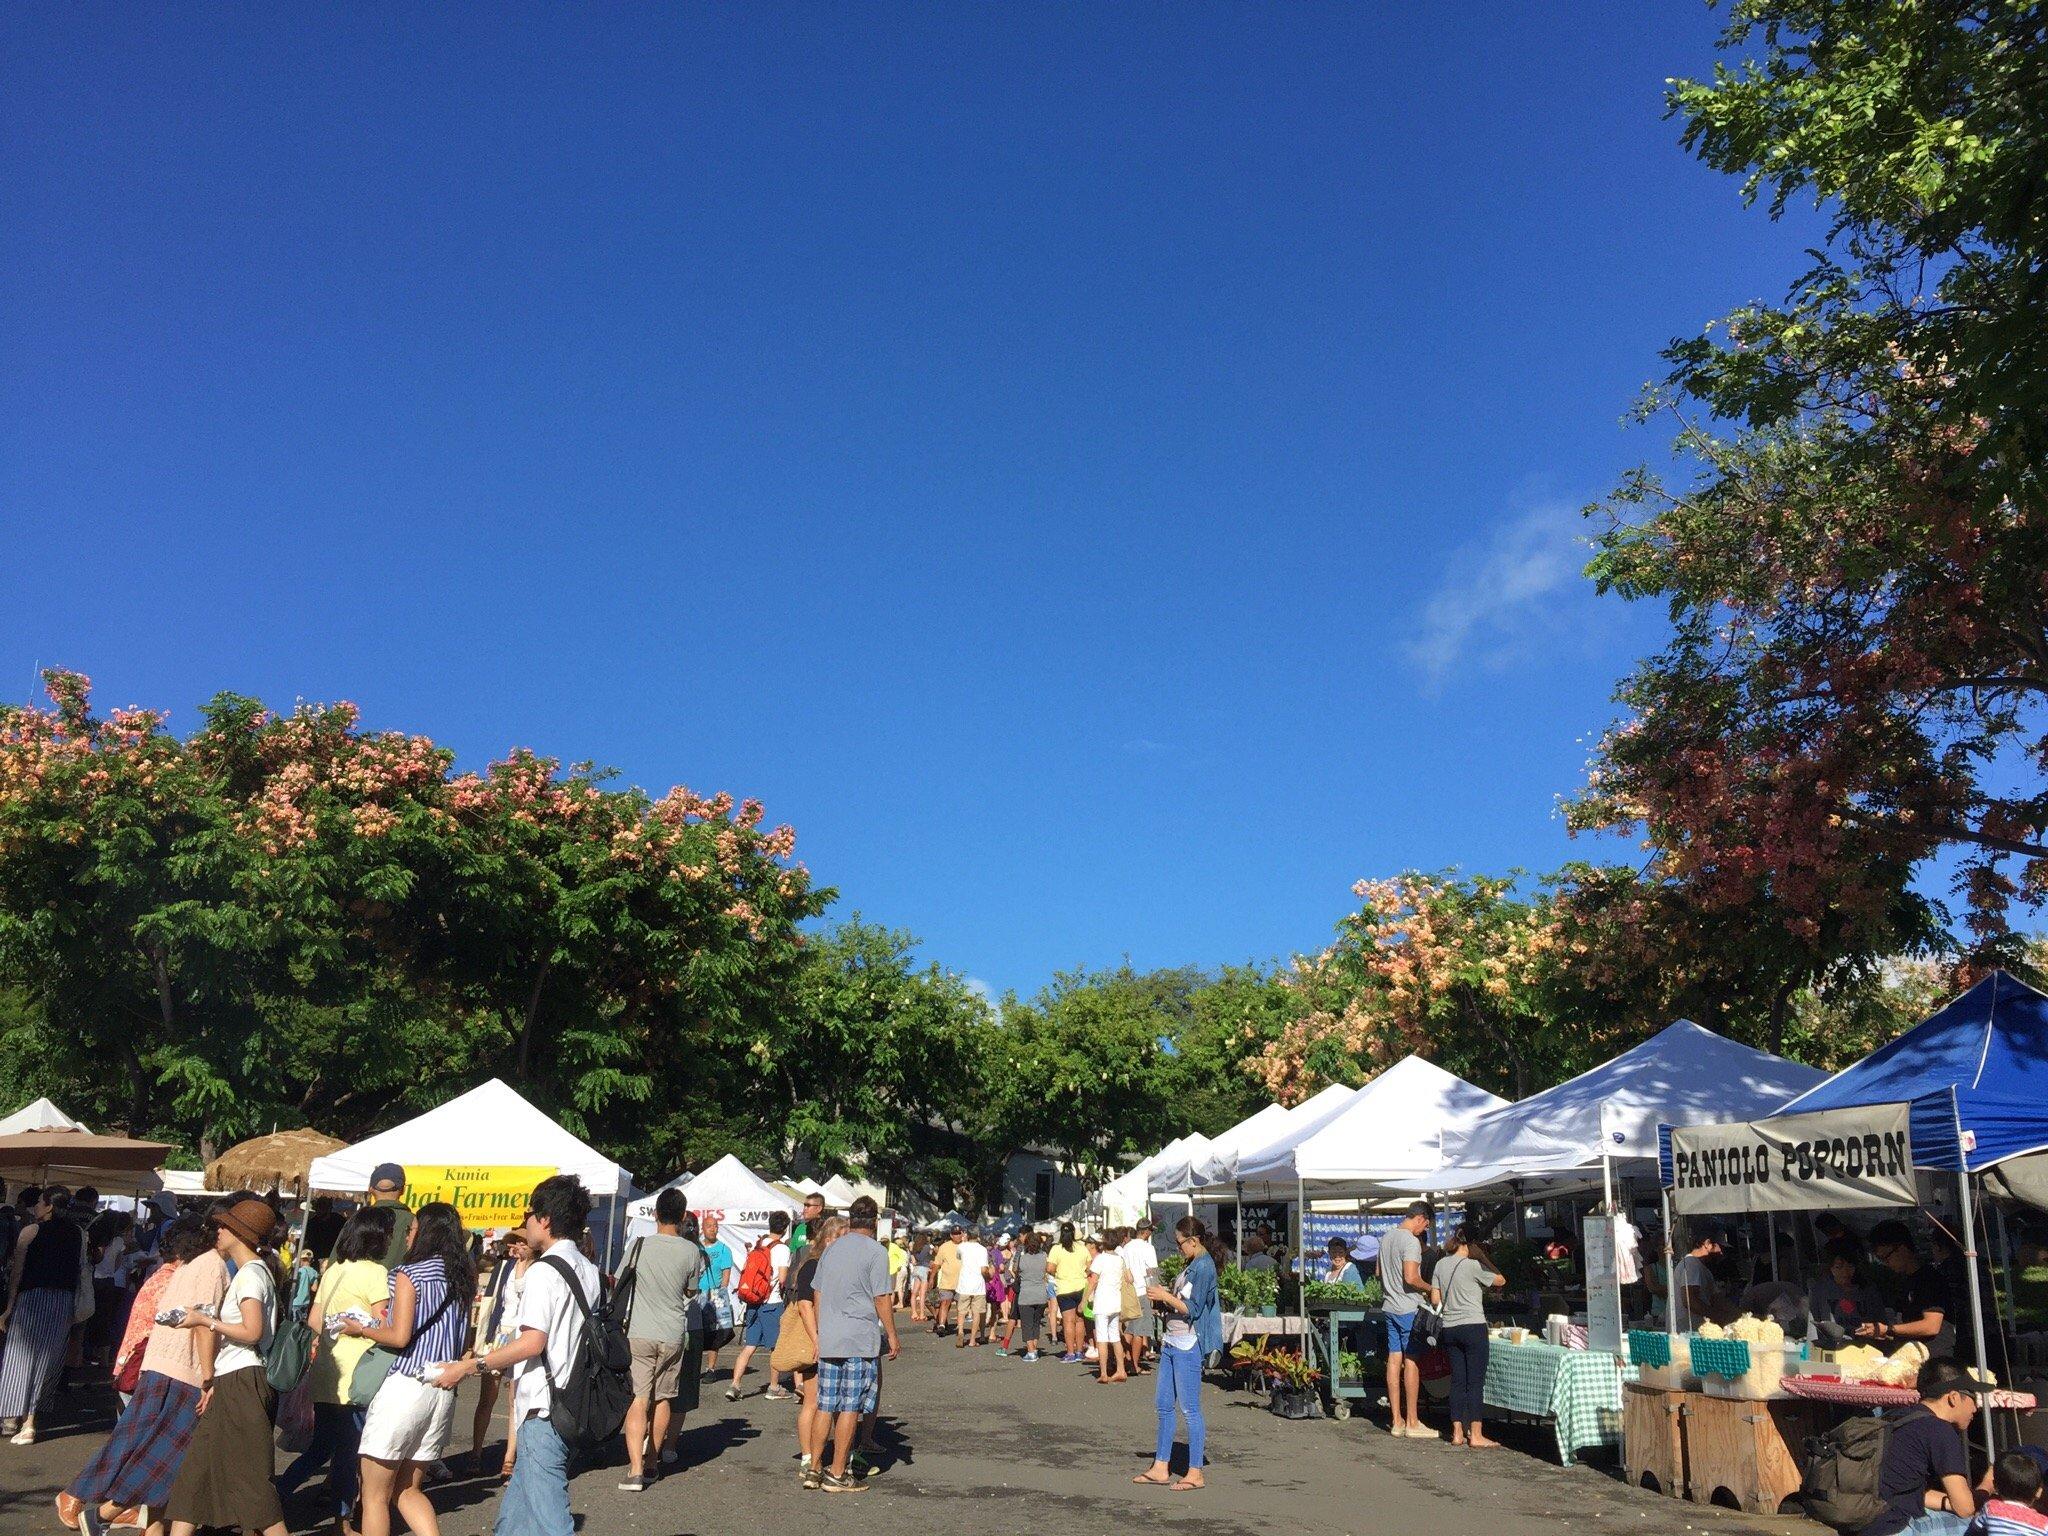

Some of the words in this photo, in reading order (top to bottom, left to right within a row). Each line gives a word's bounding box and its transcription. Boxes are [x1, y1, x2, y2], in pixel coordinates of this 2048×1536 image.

[1676, 1143, 1769, 1188] PANIOLO
[1781, 1131, 1906, 1182] POPCORN
[445, 1168, 490, 1181] Kunia
[404, 1184, 441, 1208] hai
[740, 1210, 774, 1221] SAVO
[1240, 1208, 1269, 1218] RAW
[1230, 1219, 1276, 1230] VEGAN
